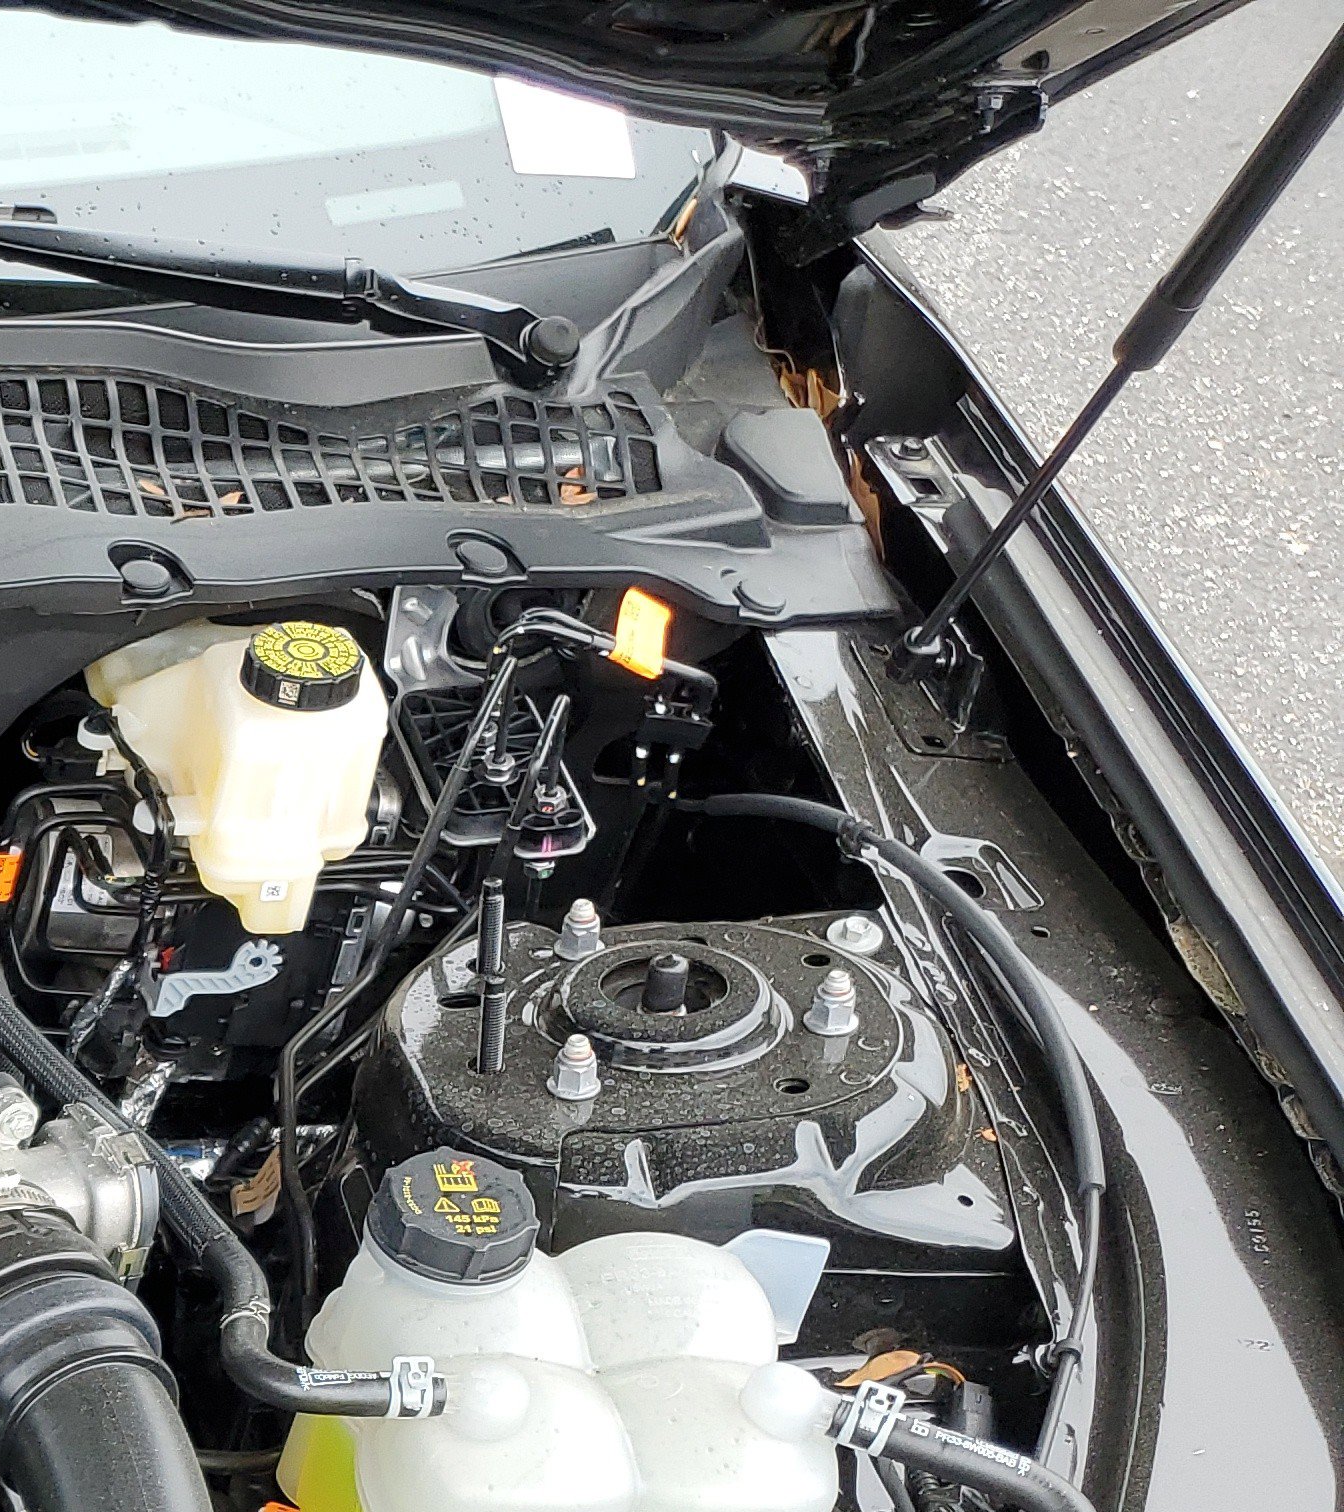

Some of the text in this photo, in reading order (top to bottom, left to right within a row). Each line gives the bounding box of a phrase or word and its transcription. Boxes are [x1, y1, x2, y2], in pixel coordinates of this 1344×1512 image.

[445, 1213, 500, 1224] 145 kPa
[475, 1224, 498, 1235] psi
